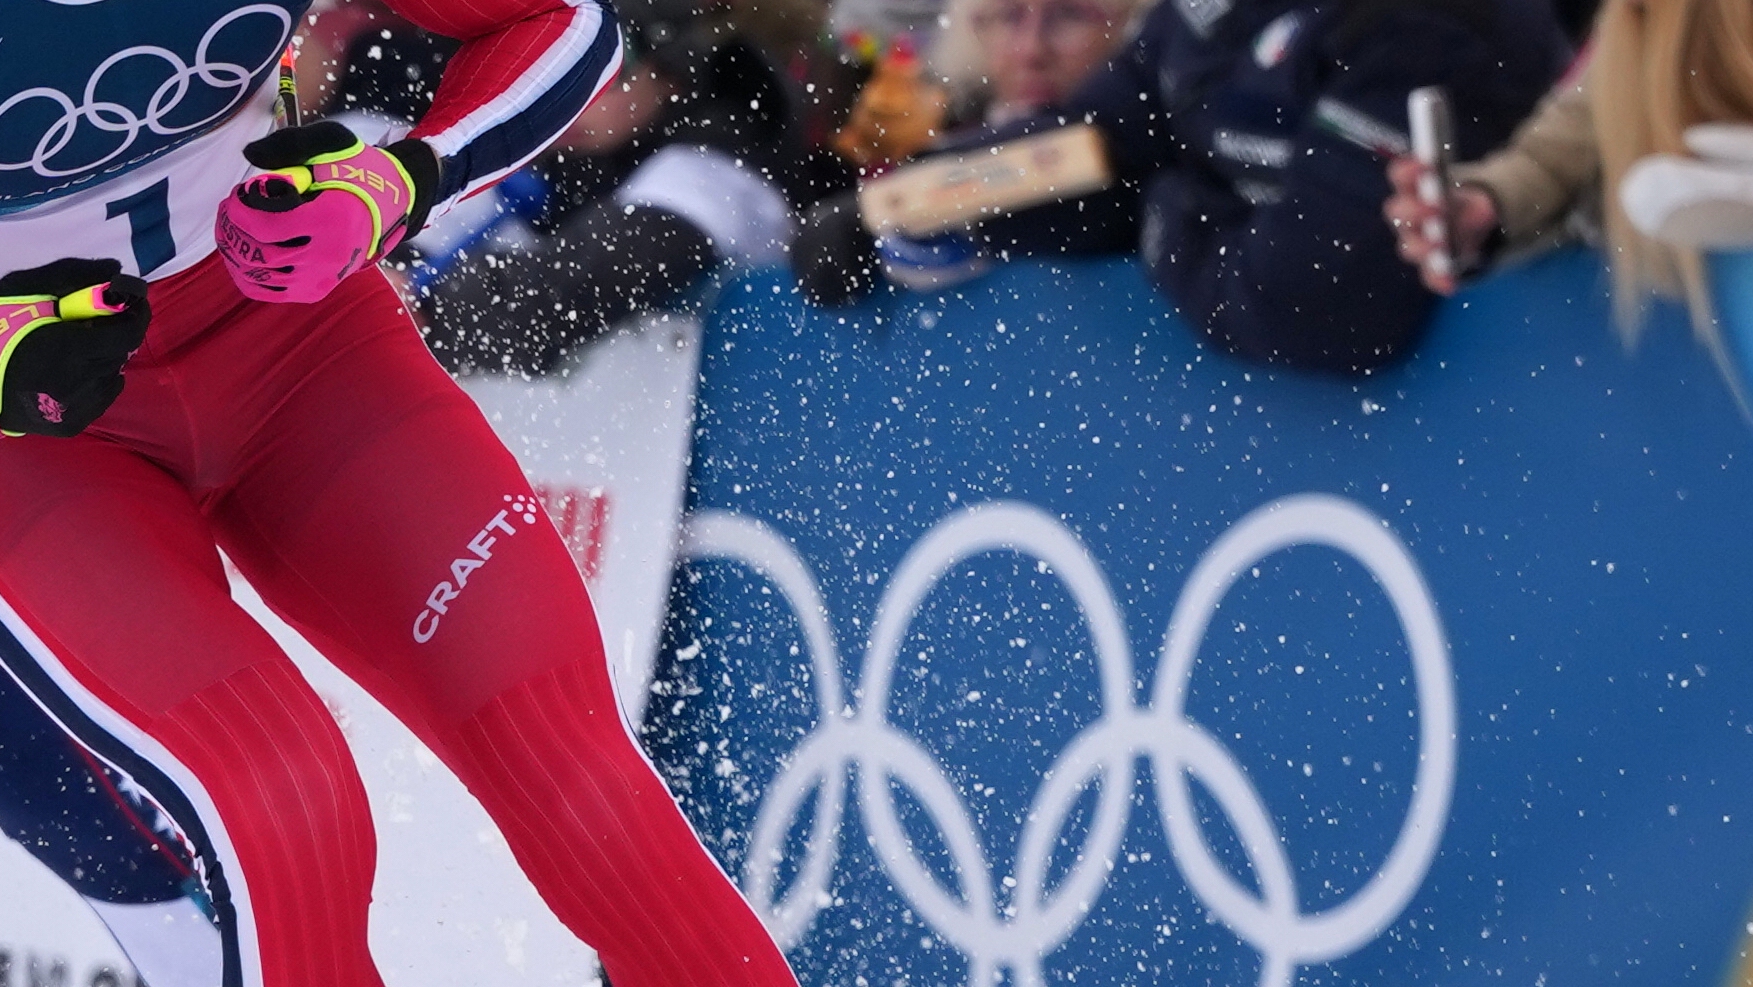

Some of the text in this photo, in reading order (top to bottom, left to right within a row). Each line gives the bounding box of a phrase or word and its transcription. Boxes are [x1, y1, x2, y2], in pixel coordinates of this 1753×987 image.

[104, 175, 177, 278] 1
[330, 164, 401, 205] LEKI
[412, 509, 517, 644] CRAFT
